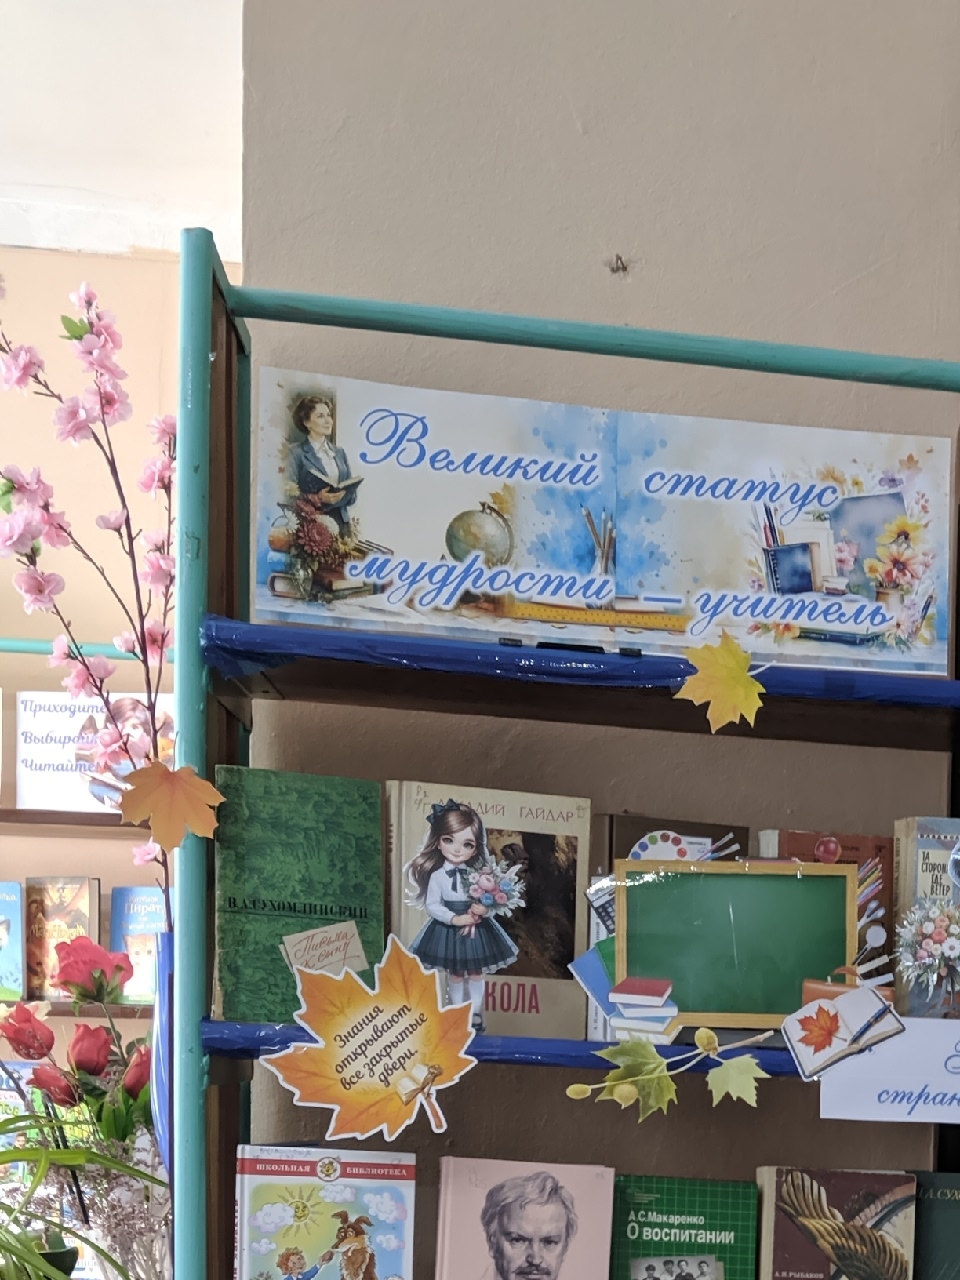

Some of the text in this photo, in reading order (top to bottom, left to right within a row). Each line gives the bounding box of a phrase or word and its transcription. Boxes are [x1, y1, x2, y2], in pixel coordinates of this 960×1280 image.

[358, 407, 840, 527] Великий статус
[347, 551, 613, 611] мудрости
[688, 586, 896, 634] учитель
[519, 804, 575, 823] ГАЙДАР
[930, 884, 951, 897] ВЕТЕР
[293, 930, 355, 960] Письма
[485, 982, 541, 1014] КОЛА
[334, 1003, 385, 1050] Знания
[334, 1002, 412, 1075] открывают
[340, 1011, 429, 1091] все закрытые
[377, 1048, 419, 1089] двери.
[256, 1163, 408, 1177] ШКОЛЬНАЯ БИБЛИОТЕКА
[626, 1222, 736, 1245] О воспитании
